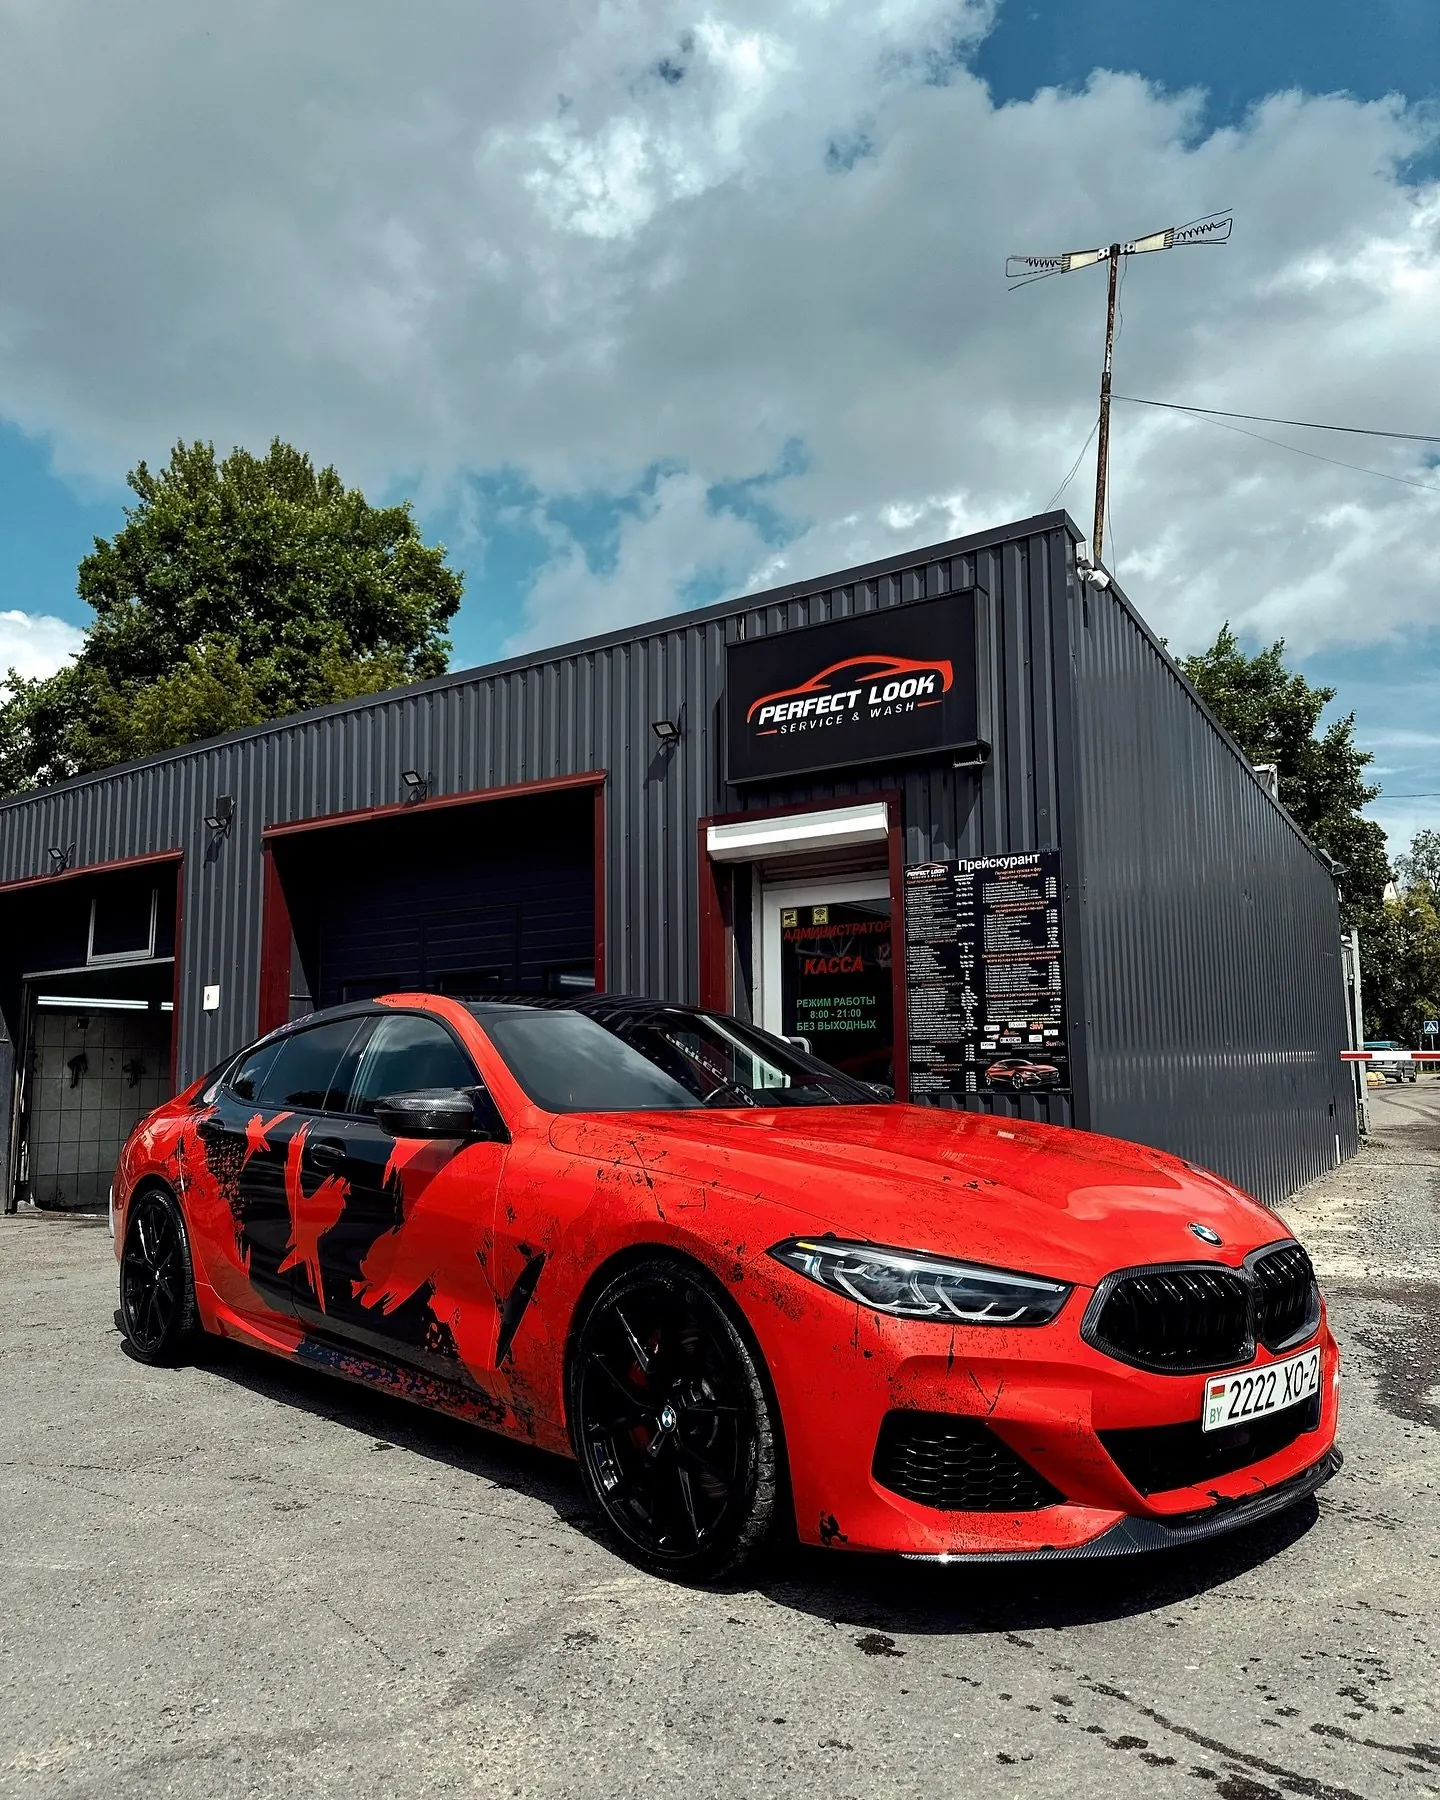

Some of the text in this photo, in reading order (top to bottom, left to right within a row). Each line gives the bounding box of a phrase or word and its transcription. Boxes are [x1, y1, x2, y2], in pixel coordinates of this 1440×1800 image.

[758, 674, 936, 725] PERFECT LOOK
[780, 701, 915, 734] SERVICE & WASH
[958, 853, 1041, 873] Прейскурант
[783, 920, 892, 943] АДМИНИСТРАТОР
[804, 955, 864, 975] КАССА
[797, 996, 876, 1008] РЕЖИМ РАБОТЫ
[810, 1010, 829, 1019] 8:00
[837, 1009, 862, 1018] 21:00
[796, 1020, 877, 1031] БЕЗ ВЫХОДНЫХ
[1227, 1354, 1318, 1421] 2222 XO-2
[1209, 1406, 1223, 1424] BY
